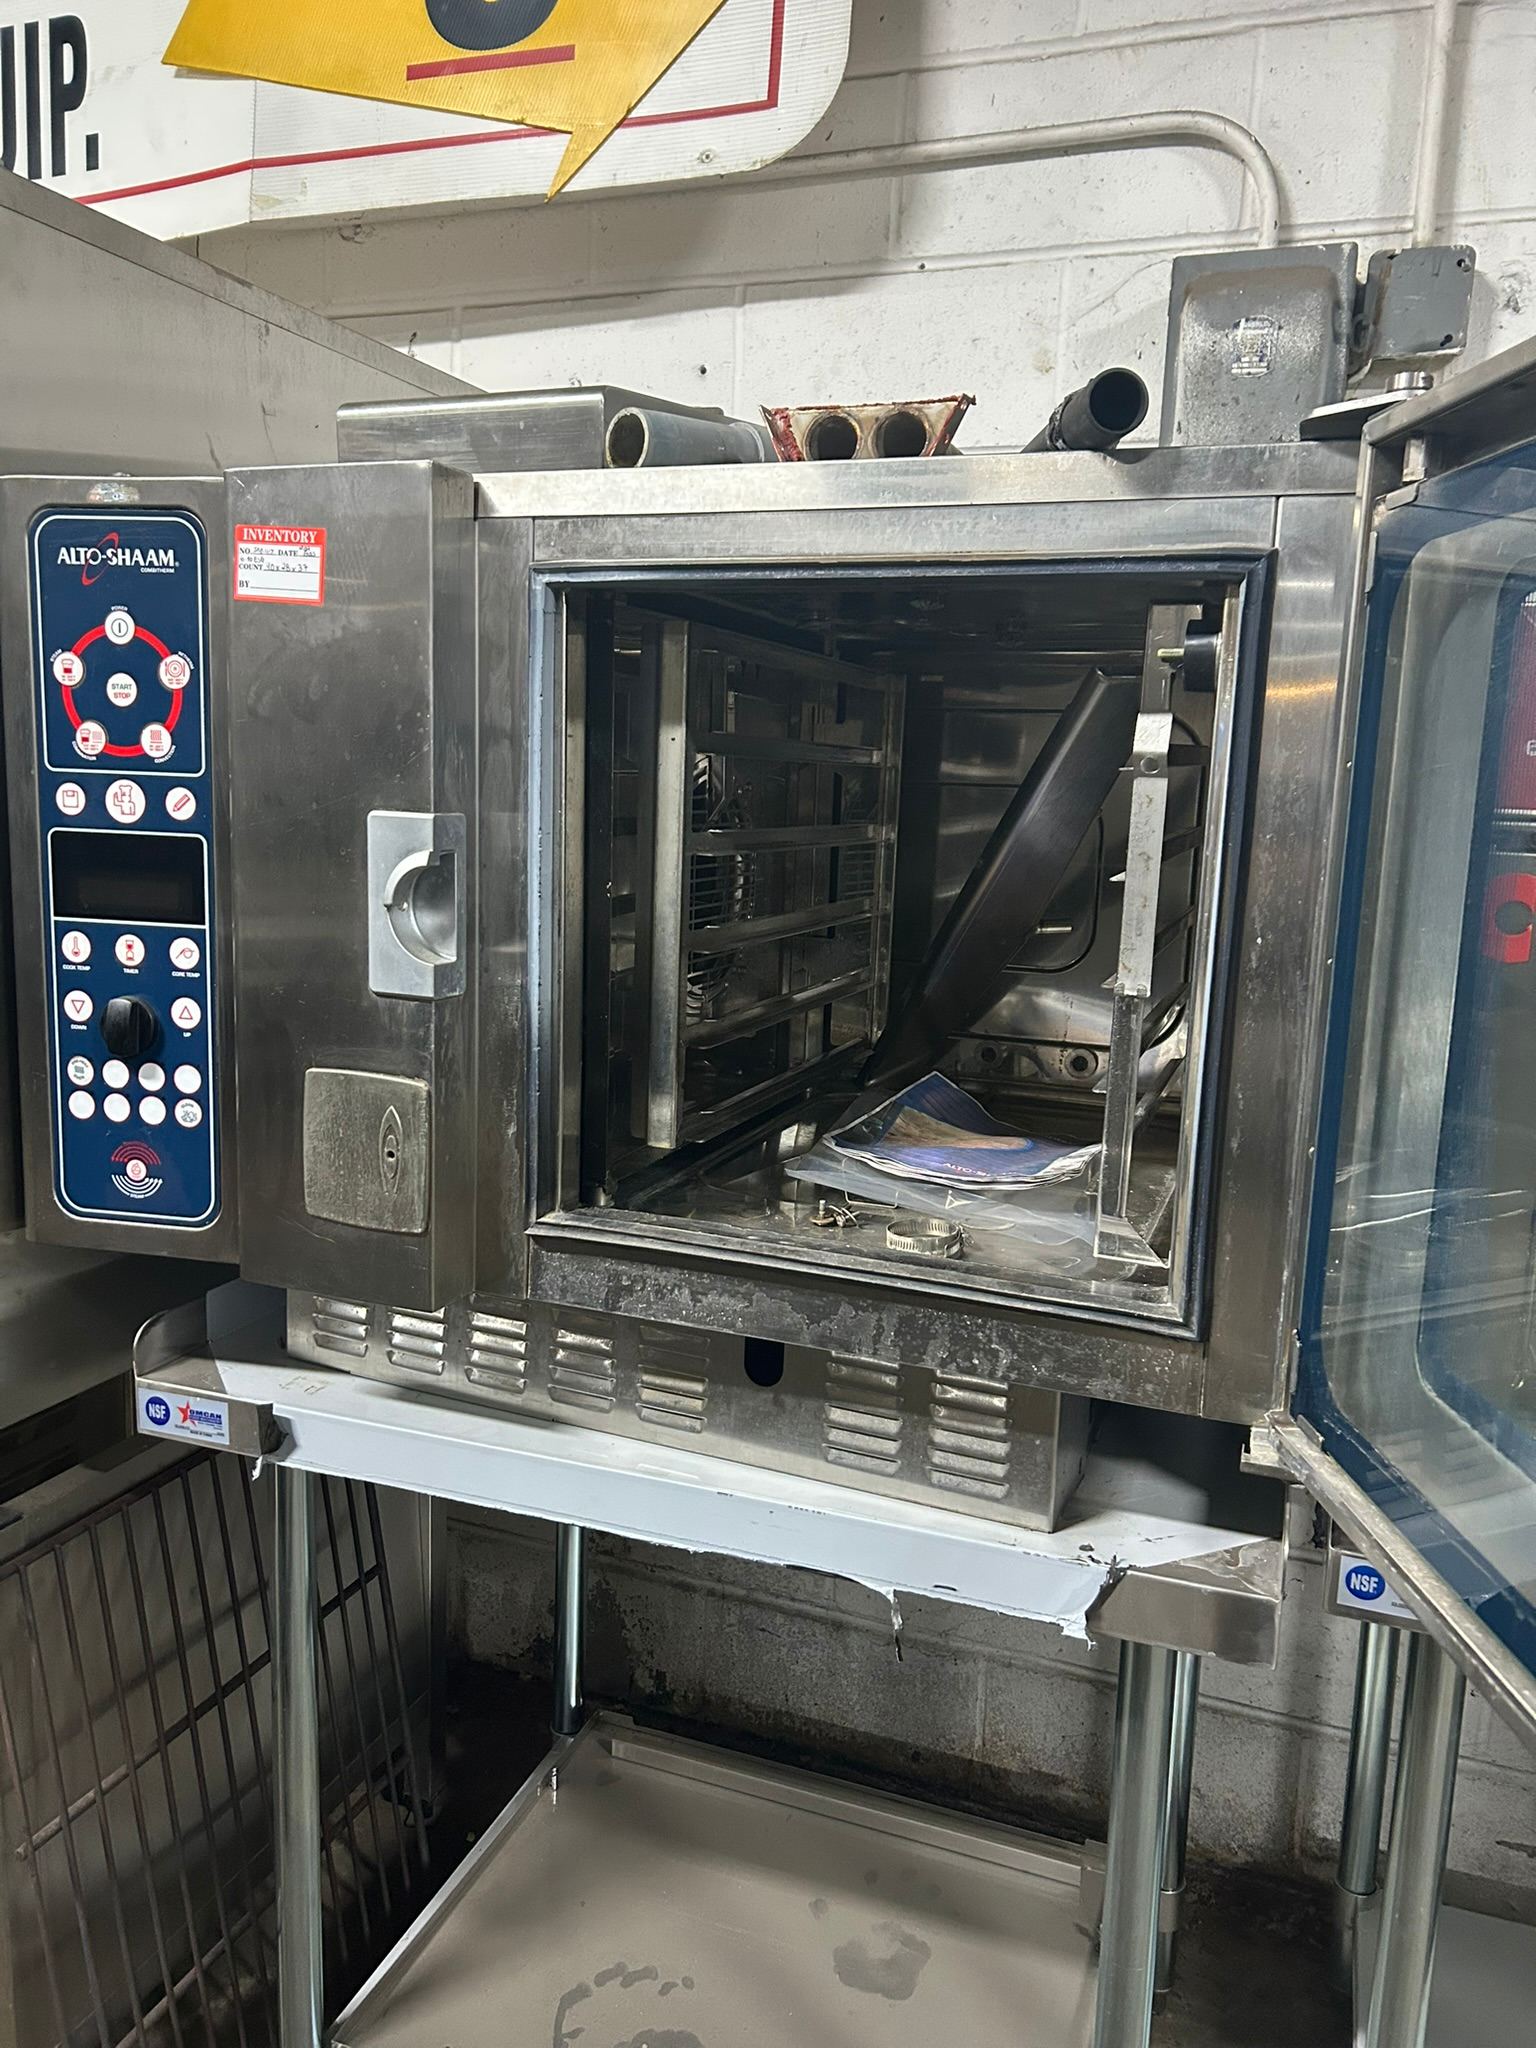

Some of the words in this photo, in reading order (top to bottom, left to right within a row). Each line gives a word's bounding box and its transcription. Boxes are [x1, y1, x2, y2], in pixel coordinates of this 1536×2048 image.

[243, 528, 317, 543] INVENTORY
[57, 546, 175, 567] ALTO-SHAAM
[278, 549, 298, 557] DATE
[239, 563, 263, 571] COUNT
[239, 580, 250, 588] BY
[148, 1403, 166, 1419] NSF
[189, 1409, 222, 1419] OMCAN
[1350, 1572, 1379, 1593] NSF
